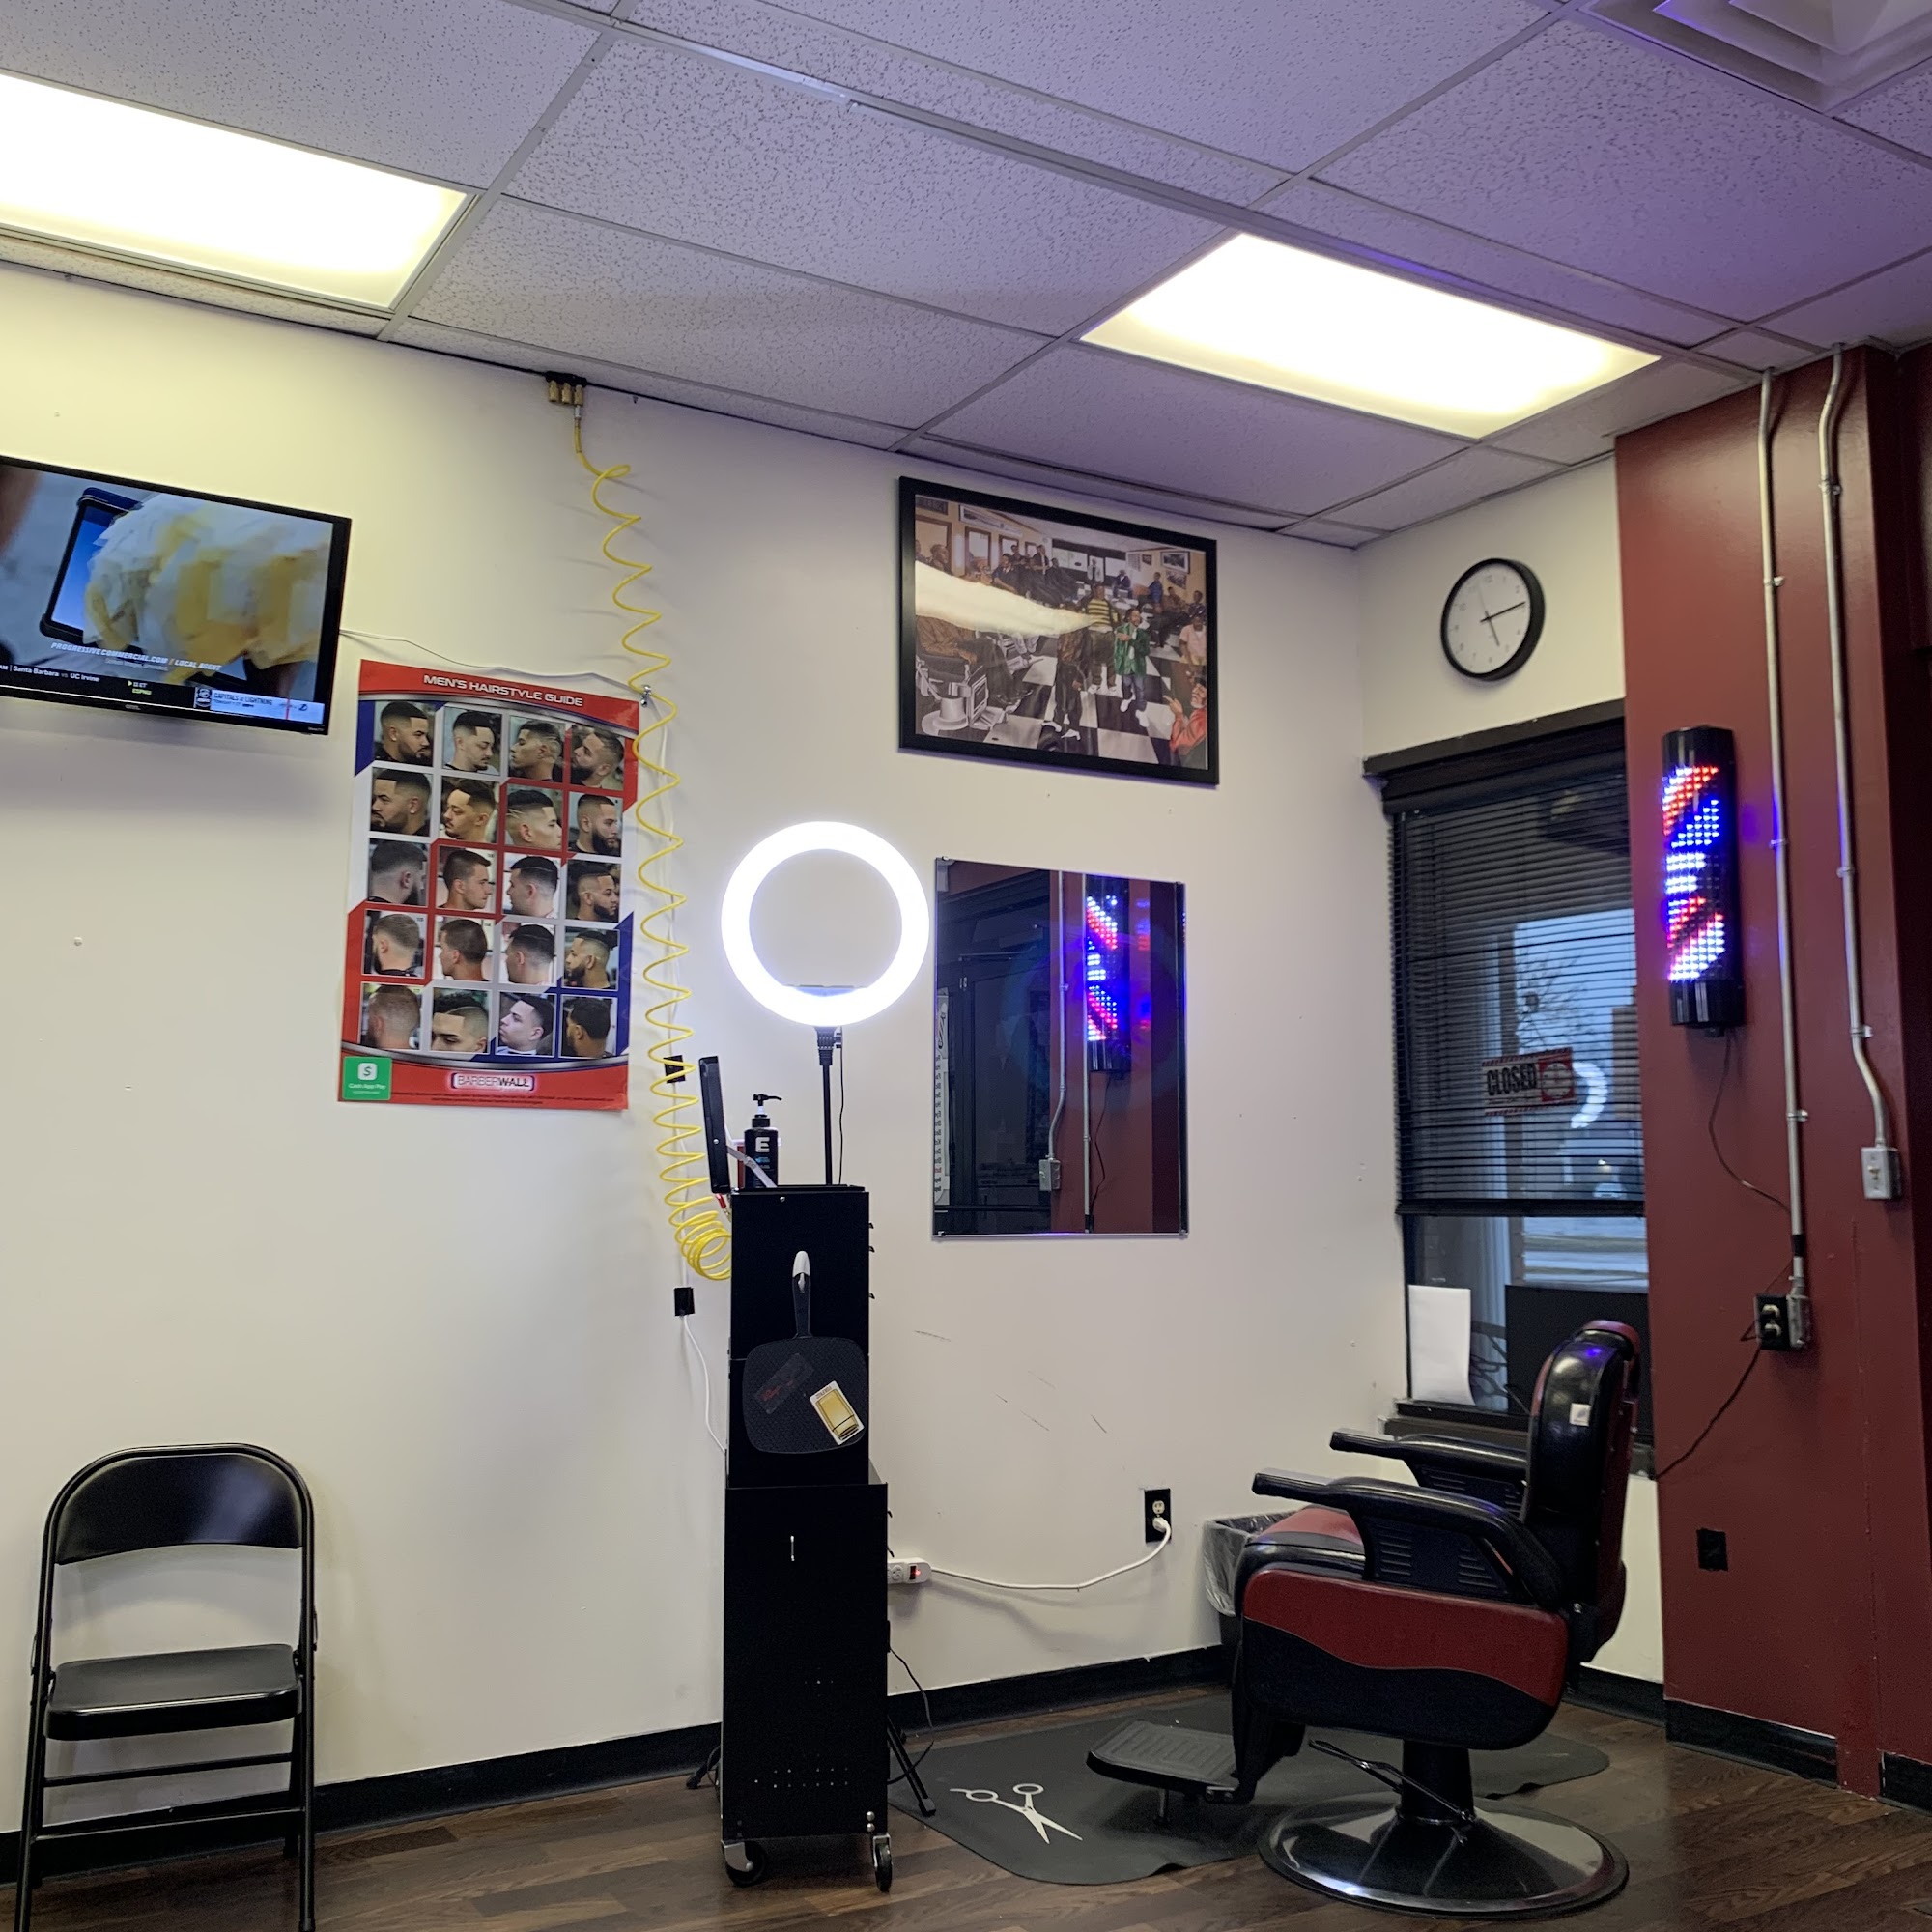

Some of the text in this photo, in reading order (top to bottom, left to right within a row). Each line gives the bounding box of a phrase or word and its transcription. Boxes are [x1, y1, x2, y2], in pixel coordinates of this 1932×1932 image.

[14, 665, 32, 674] Santa
[34, 668, 60, 677] Barbara
[174, 659, 198, 668] LOCAL
[198, 662, 223, 671] AGENT
[423, 674, 583, 707] MEN'S HAIRSTYLE GUIDE
[213, 692, 239, 701] CAPITALS
[244, 696, 273, 706] LIGHTNING
[457, 1074, 530, 1088] BARBERWALL
[1487, 1063, 1537, 1096] CLOSED
[755, 1136, 770, 1153] E
